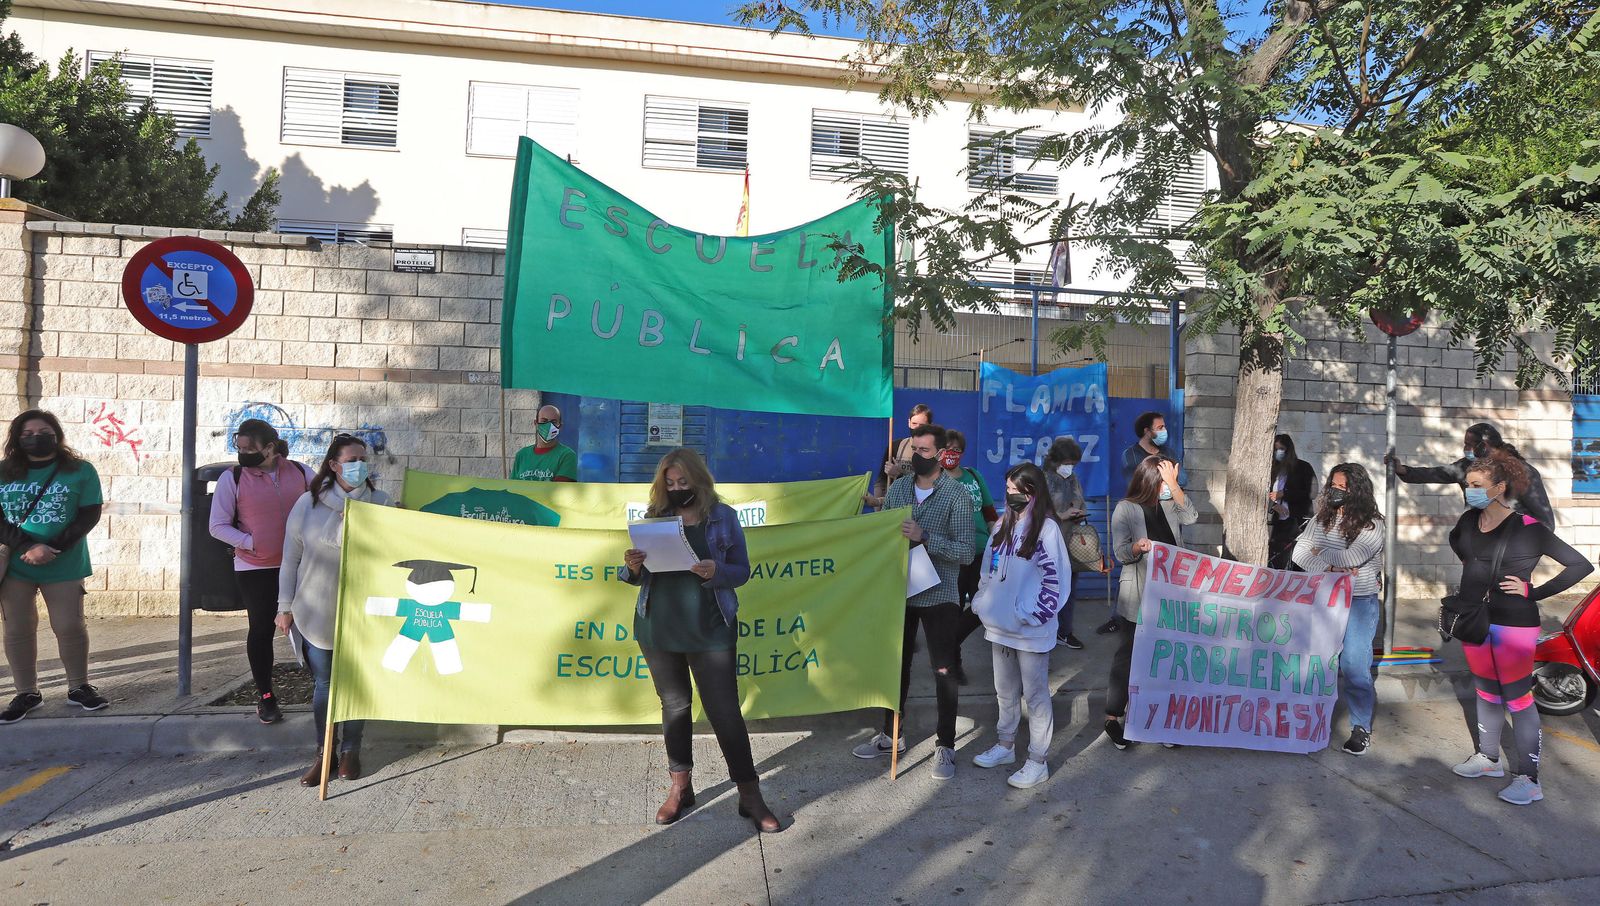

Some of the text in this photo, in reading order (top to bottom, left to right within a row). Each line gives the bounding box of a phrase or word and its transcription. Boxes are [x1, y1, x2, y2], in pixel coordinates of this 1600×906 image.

[559, 187, 857, 272] ESCUELA
[166, 260, 214, 272] EXCEPTO
[159, 313, 212, 322] 11,5 metros
[546, 282, 845, 371] PÚBLICA
[982, 380, 1106, 413] FLAMPA
[738, 507, 766, 527] ATER
[554, 564, 593, 581] IES
[751, 558, 835, 580] AVATER
[1151, 544, 1353, 608] REMEDIOS A
[414, 608, 444, 618] ESCUELA
[574, 621, 605, 641] EN
[739, 618, 765, 638] DE
[776, 615, 806, 636] LA
[1157, 598, 1292, 645] NUESTROS
[557, 649, 820, 679] ESCUE BLICA
[1150, 638, 1338, 697] PROBLEMAS
